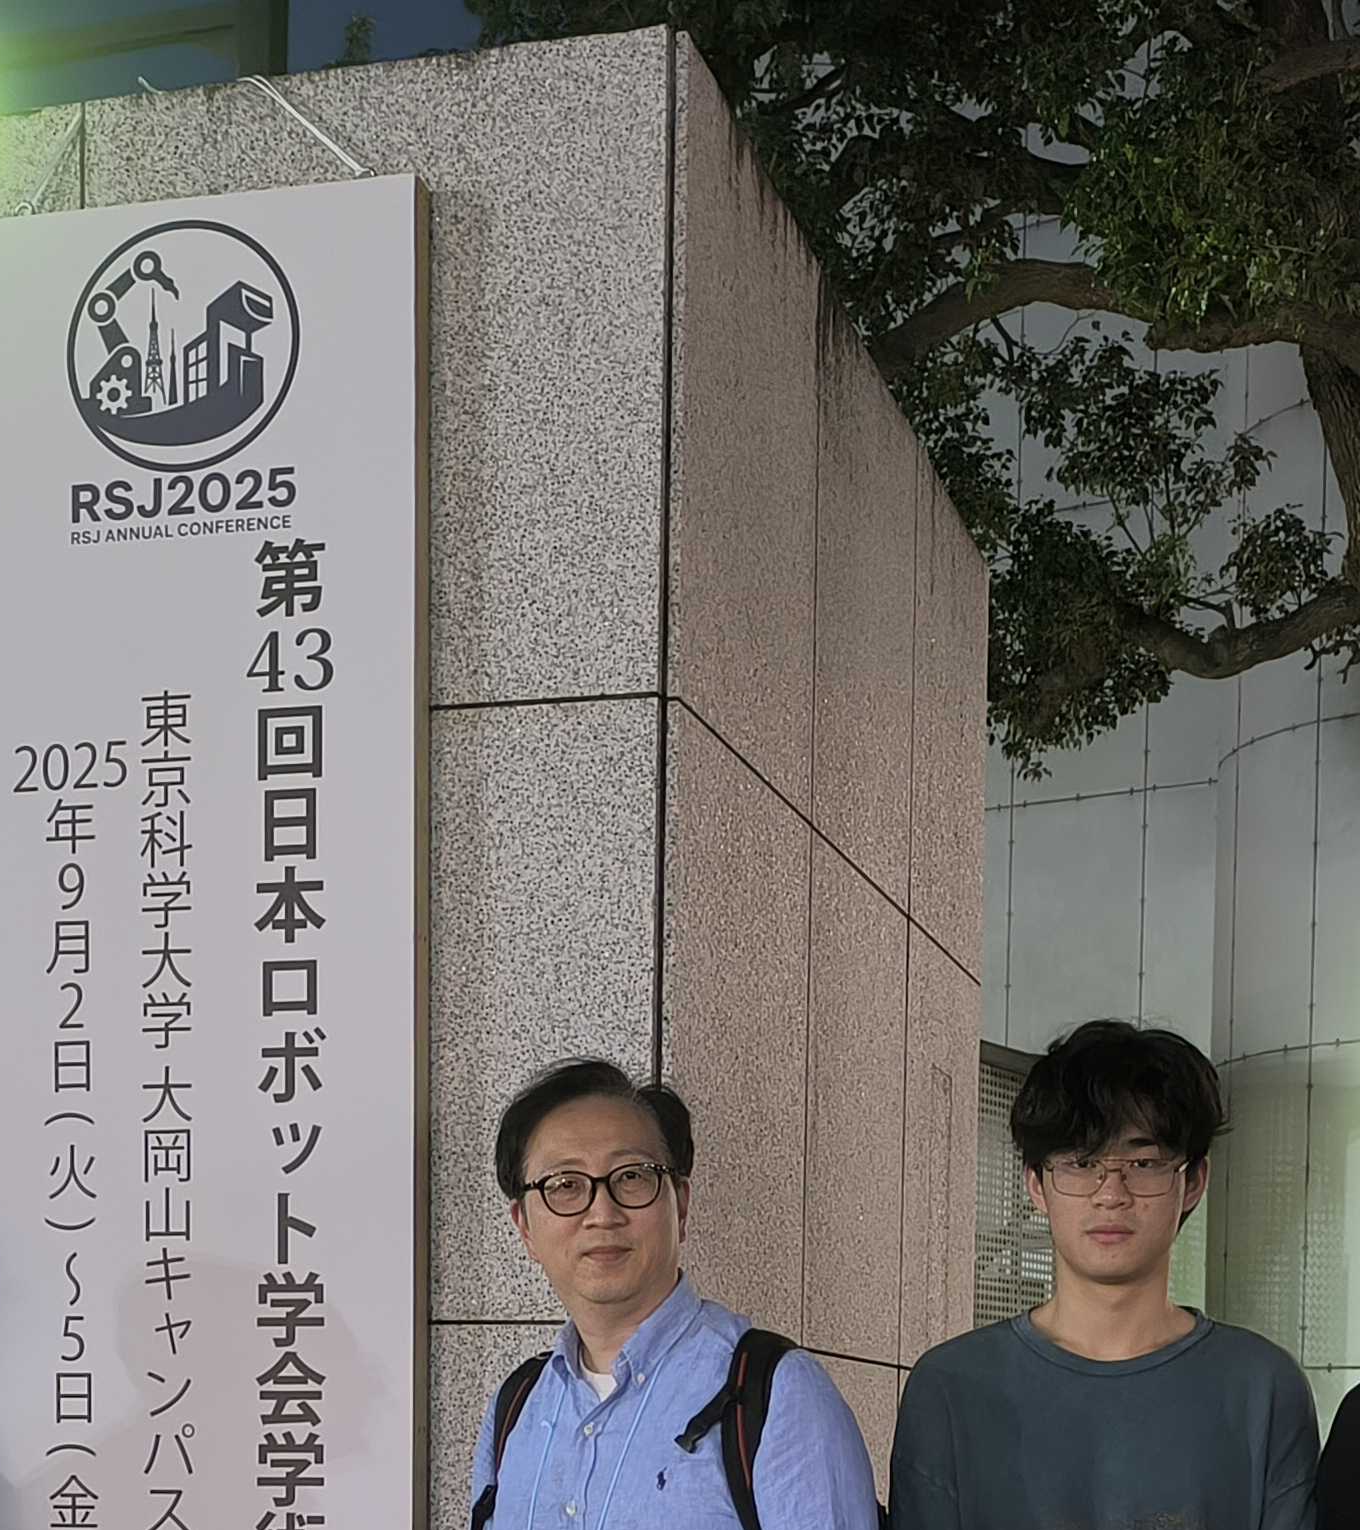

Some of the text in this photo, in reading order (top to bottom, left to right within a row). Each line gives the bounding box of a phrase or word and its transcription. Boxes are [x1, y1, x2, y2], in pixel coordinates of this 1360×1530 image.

[71, 467, 297, 523] RSJ2025
[71, 514, 292, 544] RSJ ANNUAL CONFERENCE
[140, 690, 193, 1049] 東京科学大学
